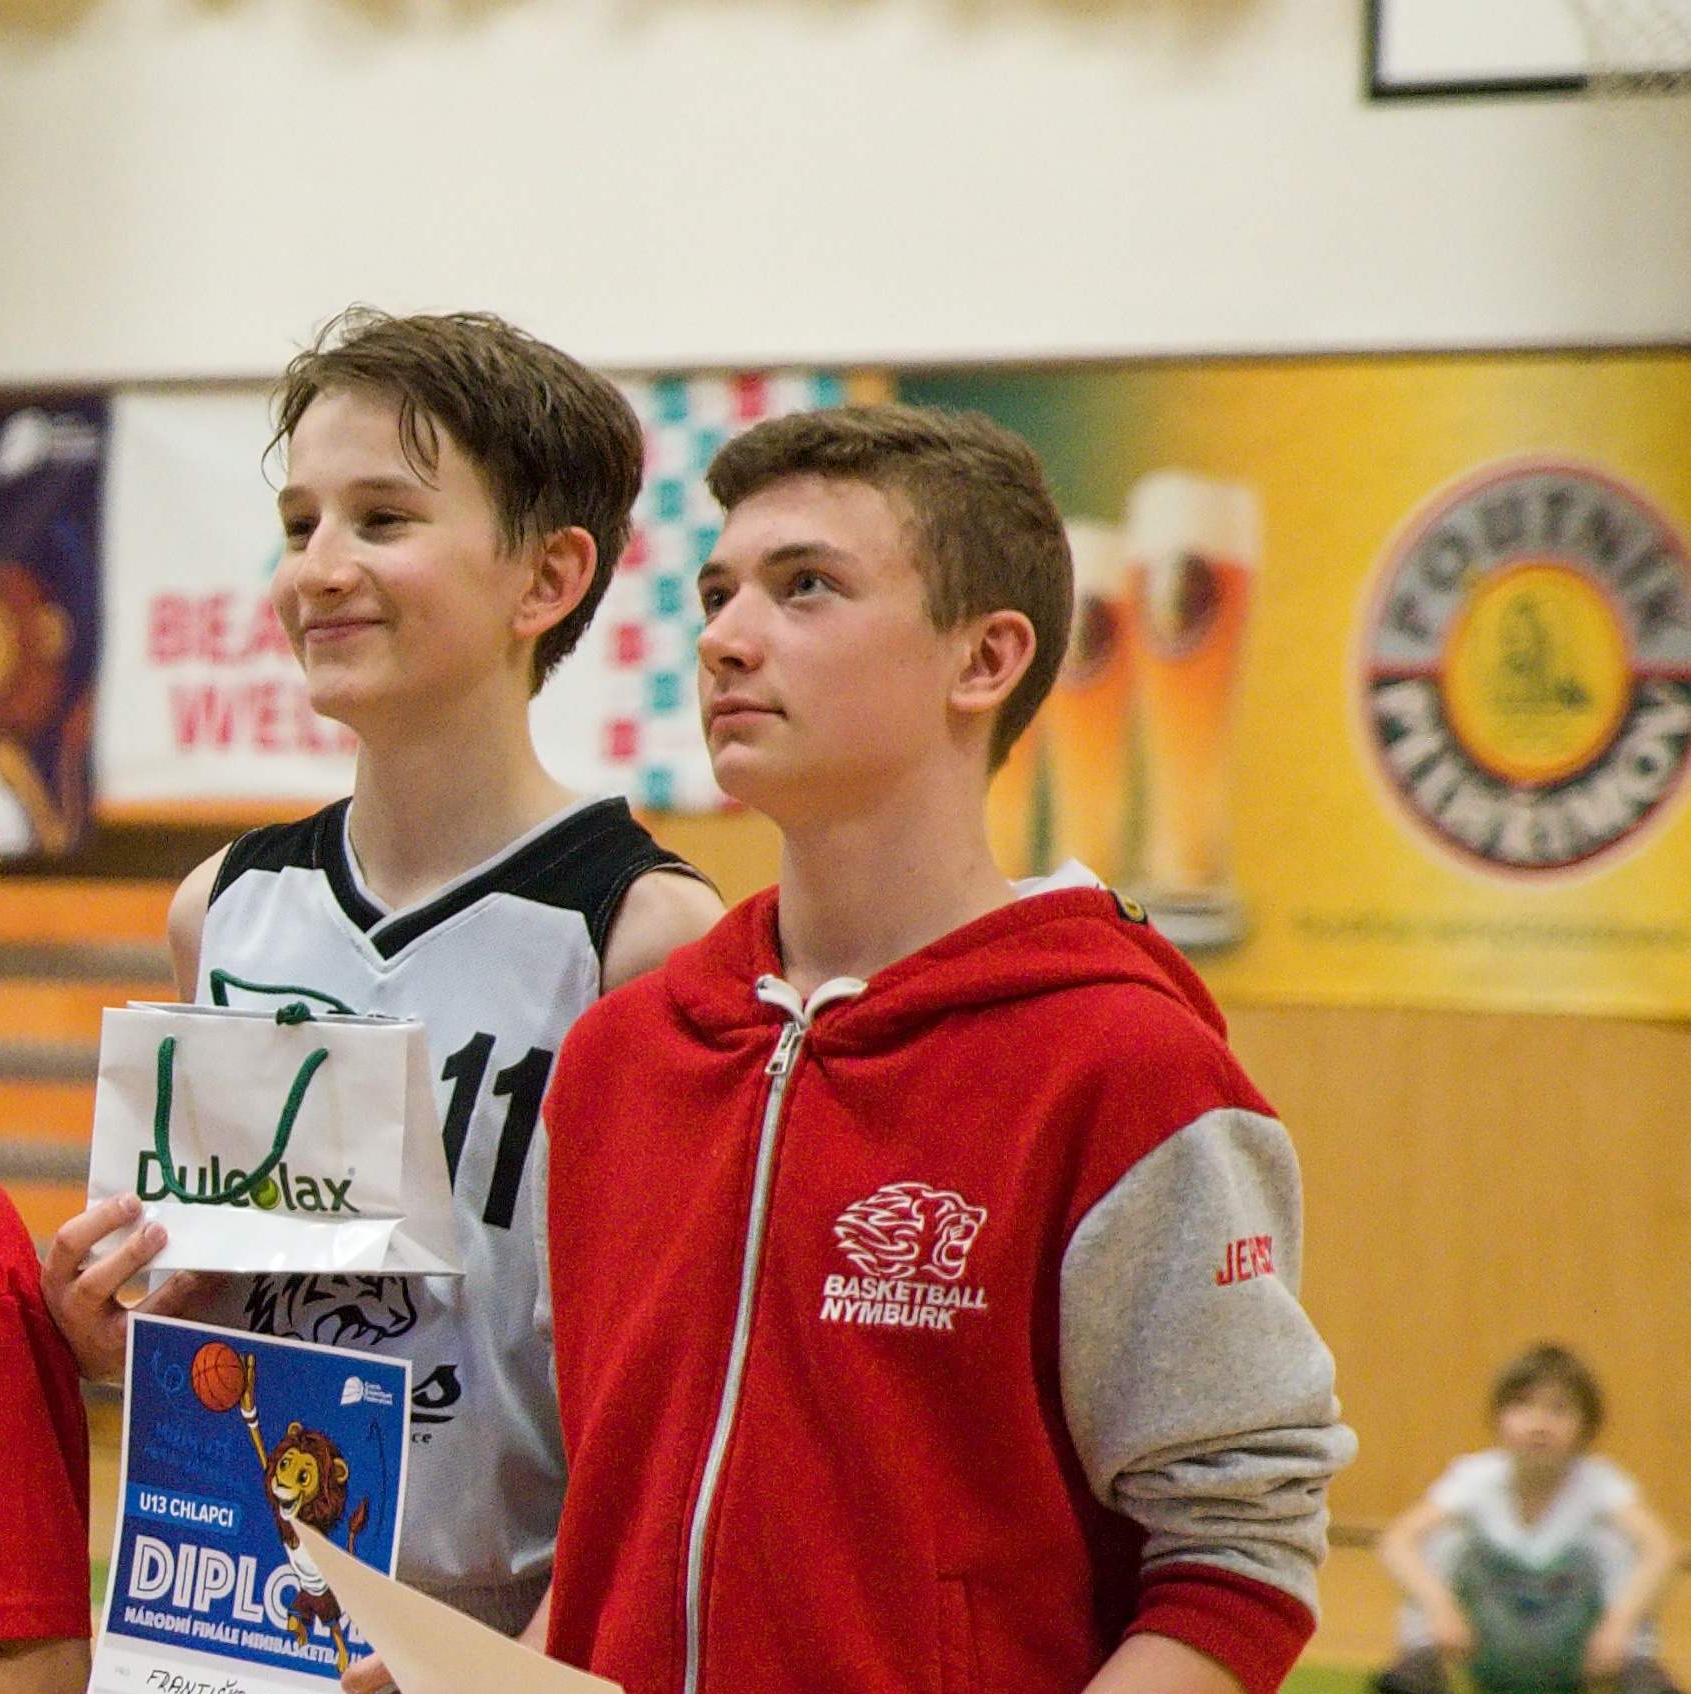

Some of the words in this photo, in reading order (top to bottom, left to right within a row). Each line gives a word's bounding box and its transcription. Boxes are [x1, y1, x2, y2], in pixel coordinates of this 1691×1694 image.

[441, 1031, 554, 1229] 11
[824, 1275, 988, 1310] BASKETBALL
[820, 1296, 955, 1331] NYMBURK
[140, 1491, 166, 1514] U13
[169, 1498, 234, 1528] CHLAPCI
[124, 1605, 192, 1635] NÁRODNÍ
[192, 1618, 241, 1646] FINÁLE
[241, 1630, 364, 1666] MINIBASKETBAU
